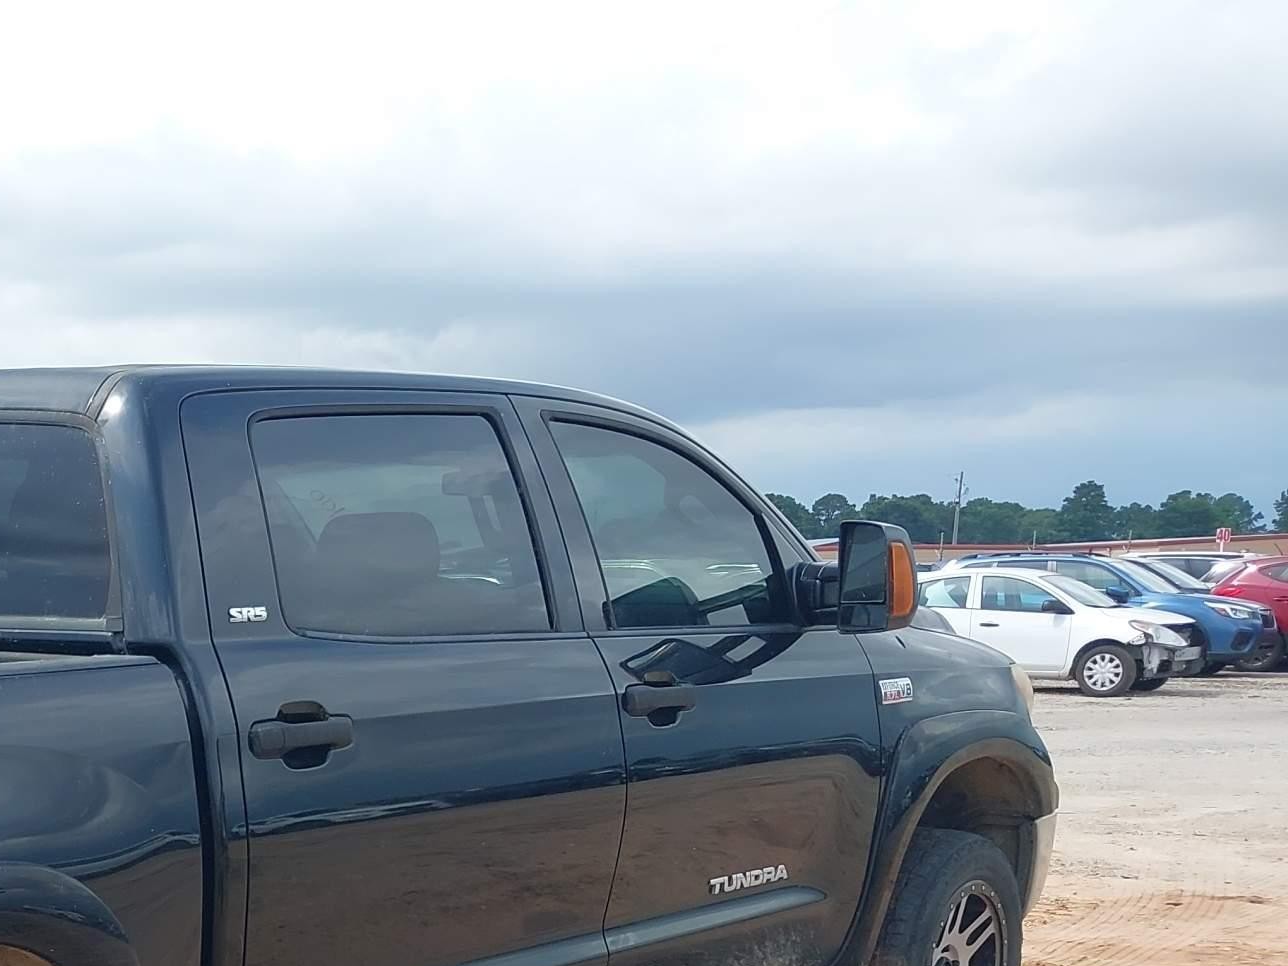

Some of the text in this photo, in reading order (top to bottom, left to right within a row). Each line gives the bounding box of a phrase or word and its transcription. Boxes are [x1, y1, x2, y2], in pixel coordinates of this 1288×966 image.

[1217, 529, 1230, 542] 40
[228, 606, 268, 623] SR5
[899, 682, 912, 698] V8
[709, 864, 790, 896] TUNDRA
